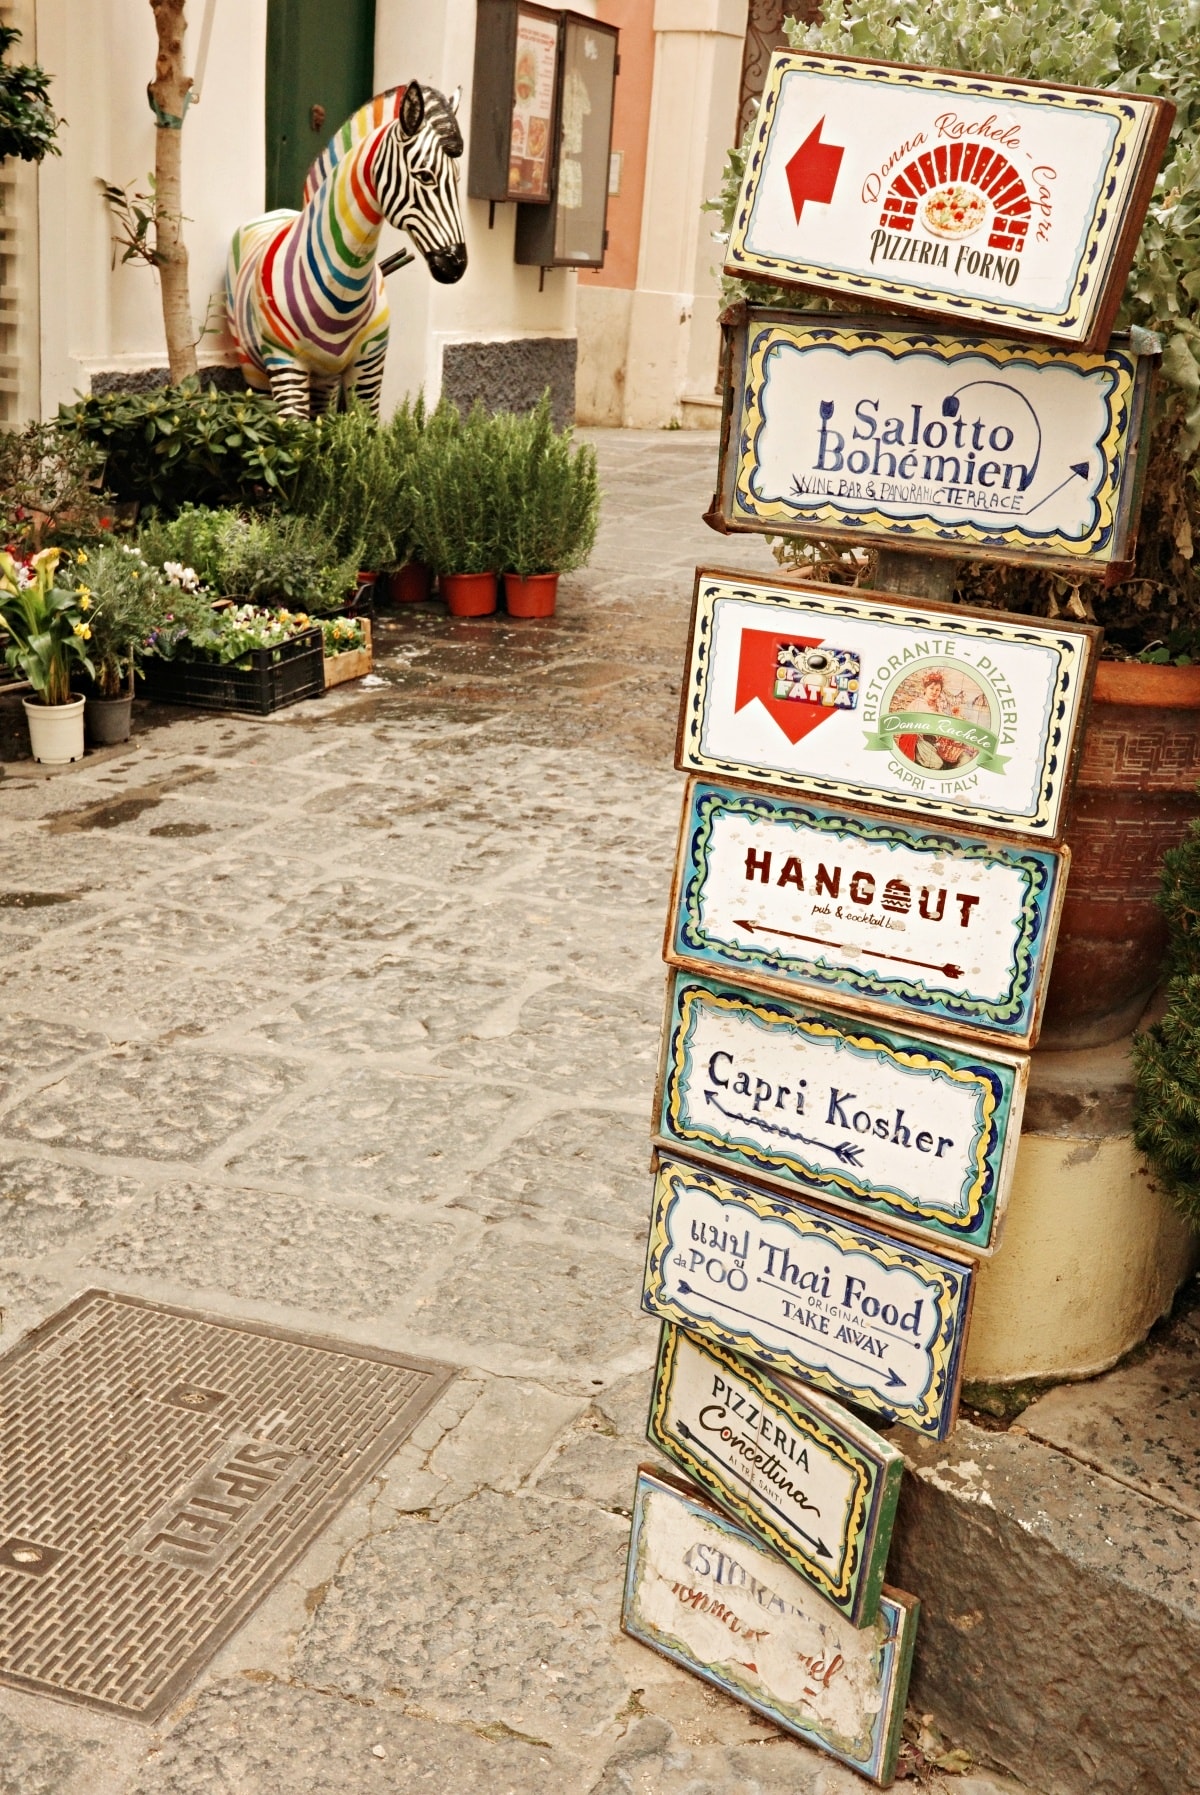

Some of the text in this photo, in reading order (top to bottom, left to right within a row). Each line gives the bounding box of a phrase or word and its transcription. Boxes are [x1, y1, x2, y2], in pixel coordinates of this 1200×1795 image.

[861, 130, 928, 205] Donna
[934, 112, 1022, 151] Rachele
[1030, 165, 1057, 244] Capri
[870, 229, 1021, 288] PIZZERIA FORNO
[852, 399, 1015, 452] Salotto
[812, 428, 1030, 492] Bohémien
[798, 475, 835, 496] WINE
[838, 479, 863, 499] BAR
[865, 480, 877, 500] &
[942, 486, 1025, 511] TERRACE
[862, 640, 956, 722] RISTORANTE
[975, 656, 1018, 745] PIZZERIA
[883, 715, 993, 749] Donna Rachele
[887, 760, 926, 791] CAPRI
[940, 774, 979, 794] ITALY
[744, 847, 980, 928] HANGOUT
[811, 903, 831, 916] pub
[834, 905, 844, 919] &
[845, 912, 886, 928] cocktail
[707, 1050, 954, 1159] Capri Kosher
[673, 1253, 687, 1269] da
[758, 1237, 925, 1337] Thai Food
[782, 1299, 890, 1360] TAKE AWAY
[808, 1296, 867, 1329] ORIGINAL
[711, 1374, 810, 1475] PIZZERIA
[759, 1479, 783, 1505] SANTI
